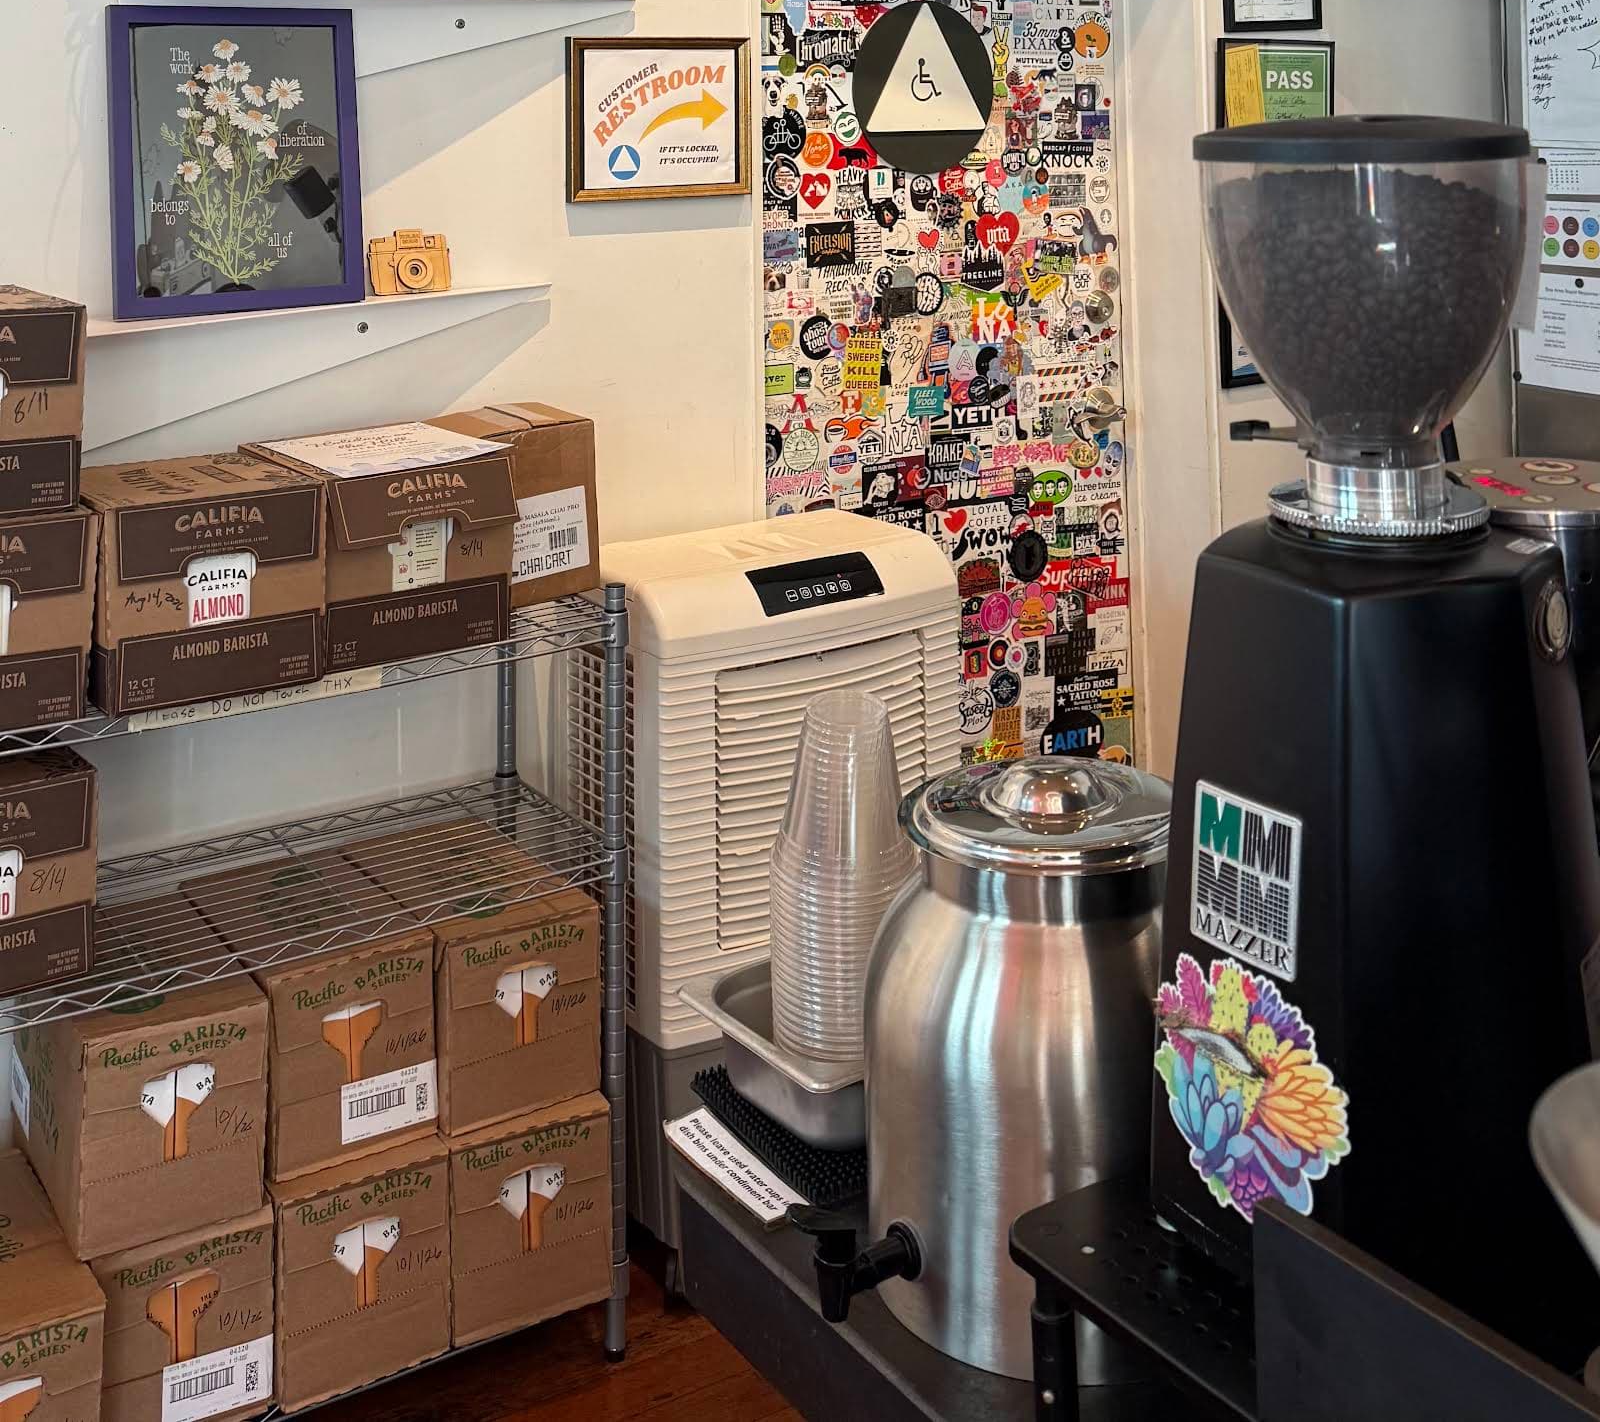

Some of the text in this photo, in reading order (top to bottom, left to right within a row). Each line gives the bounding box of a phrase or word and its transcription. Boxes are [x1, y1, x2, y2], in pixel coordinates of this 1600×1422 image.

[1035, 8, 1075, 20] CAFE
[169, 47, 190, 62] The
[169, 60, 194, 75] work
[598, 62, 660, 113] CUSTOMER
[1266, 70, 1314, 90] PASS
[592, 65, 727, 147] RESTROOM
[297, 122, 308, 136] of
[278, 132, 325, 148] liberation
[685, 145, 719, 154] LOCKED,
[677, 156, 719, 165] OCCUPIED!
[1042, 154, 1094, 168] KNOCK
[151, 198, 190, 214] belongs
[165, 212, 176, 226] to
[268, 231, 293, 247] all of
[277, 246, 288, 259] us
[963, 269, 1003, 280] TREELINE
[848, 340, 881, 349] STREET
[847, 352, 879, 362] SWEEPS
[847, 366, 878, 375] KILL
[845, 380, 878, 390] QUEERS
[858, 443, 881, 454] YETI
[1074, 482, 1097, 493] three
[971, 503, 1004, 515] LOYAL
[175, 505, 264, 533] CALIFIA
[968, 514, 1008, 527] COFFEE
[195, 525, 244, 540] FARMS
[187, 568, 248, 587] CALIFIA
[192, 593, 244, 624] ALMOND
[172, 632, 269, 661] ALMOND BARISTA
[1091, 660, 1125, 670] PIZZA
[128, 677, 155, 690] 12 CT
[1056, 678, 1116, 695] SACRED ROSE
[212, 698, 233, 715] DO
[242, 689, 266, 708] NOT
[323, 676, 353, 692] THX
[1043, 724, 1101, 755] EARTH
[520, 924, 586, 956] BARISTA
[1195, 906, 1292, 974] MAZZER
[461, 941, 513, 969] Pacific
[169, 1022, 249, 1055] BARISTA
[99, 1039, 230, 1070] Pacific SERIES
[689, 1117, 712, 1140] Please
[710, 1137, 730, 1157] leave
[728, 1154, 747, 1170] used
[745, 1166, 768, 1188] water
[765, 1186, 784, 1204] cups
[679, 1125, 779, 1212] dish bins under condiment bar
